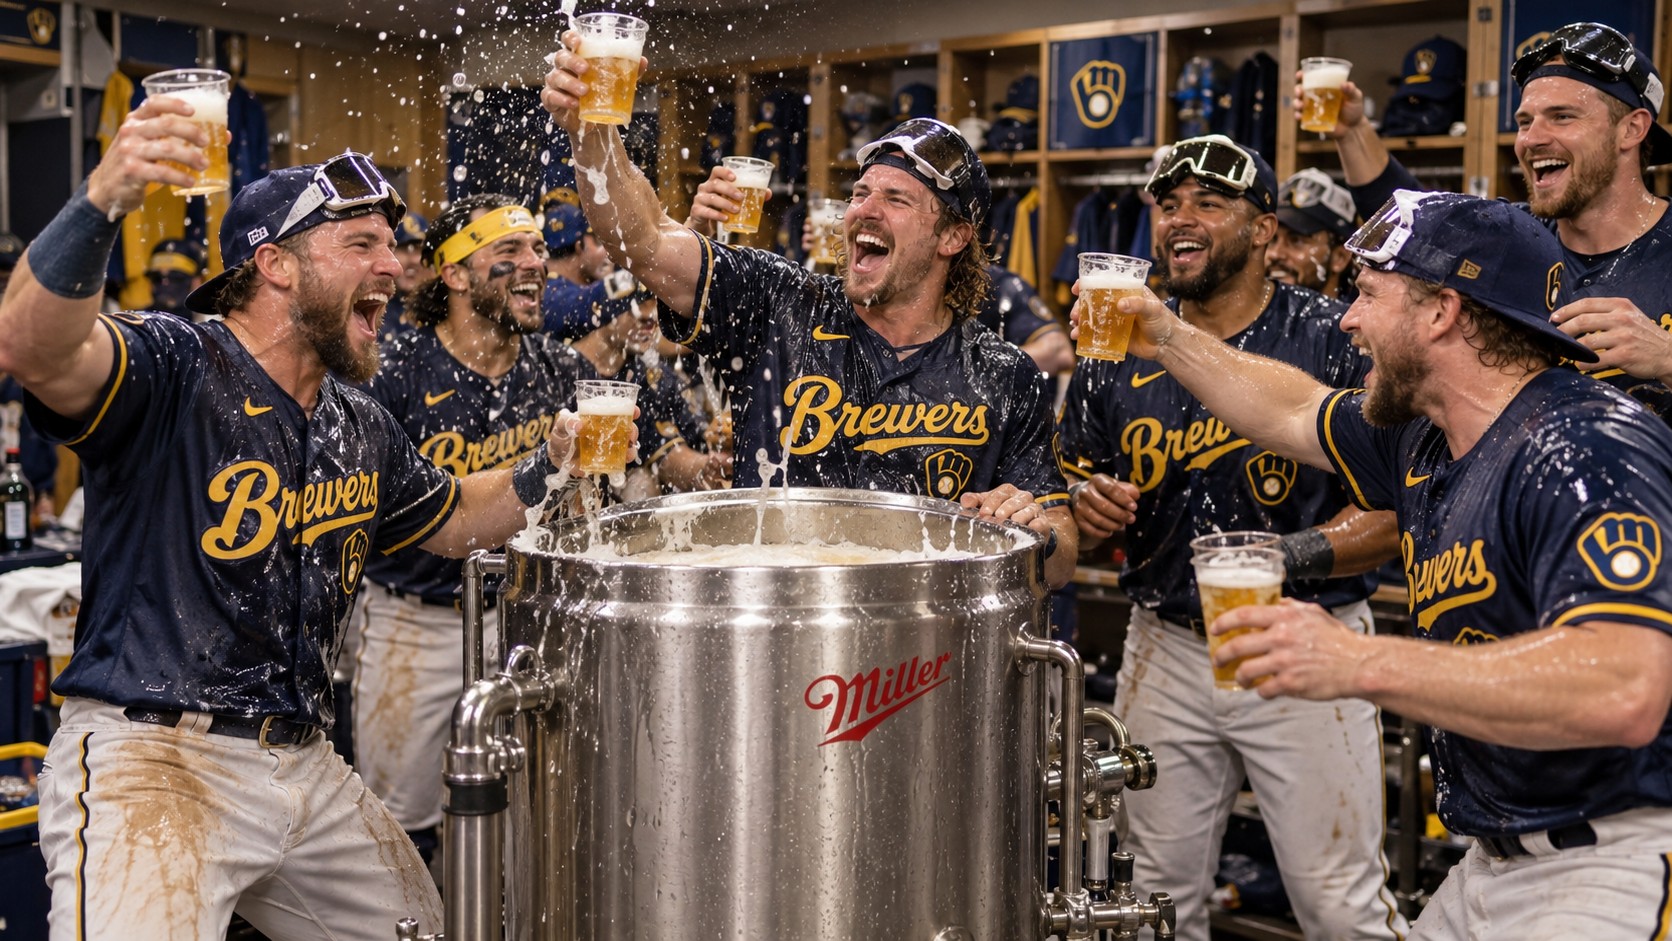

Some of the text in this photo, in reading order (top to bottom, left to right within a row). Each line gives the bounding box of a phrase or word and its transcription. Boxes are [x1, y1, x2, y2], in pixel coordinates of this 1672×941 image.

[419, 411, 560, 478] Brewer
[780, 374, 990, 455] Brewers
[201, 459, 380, 560] Brewers
[804, 651, 952, 737] Miller
